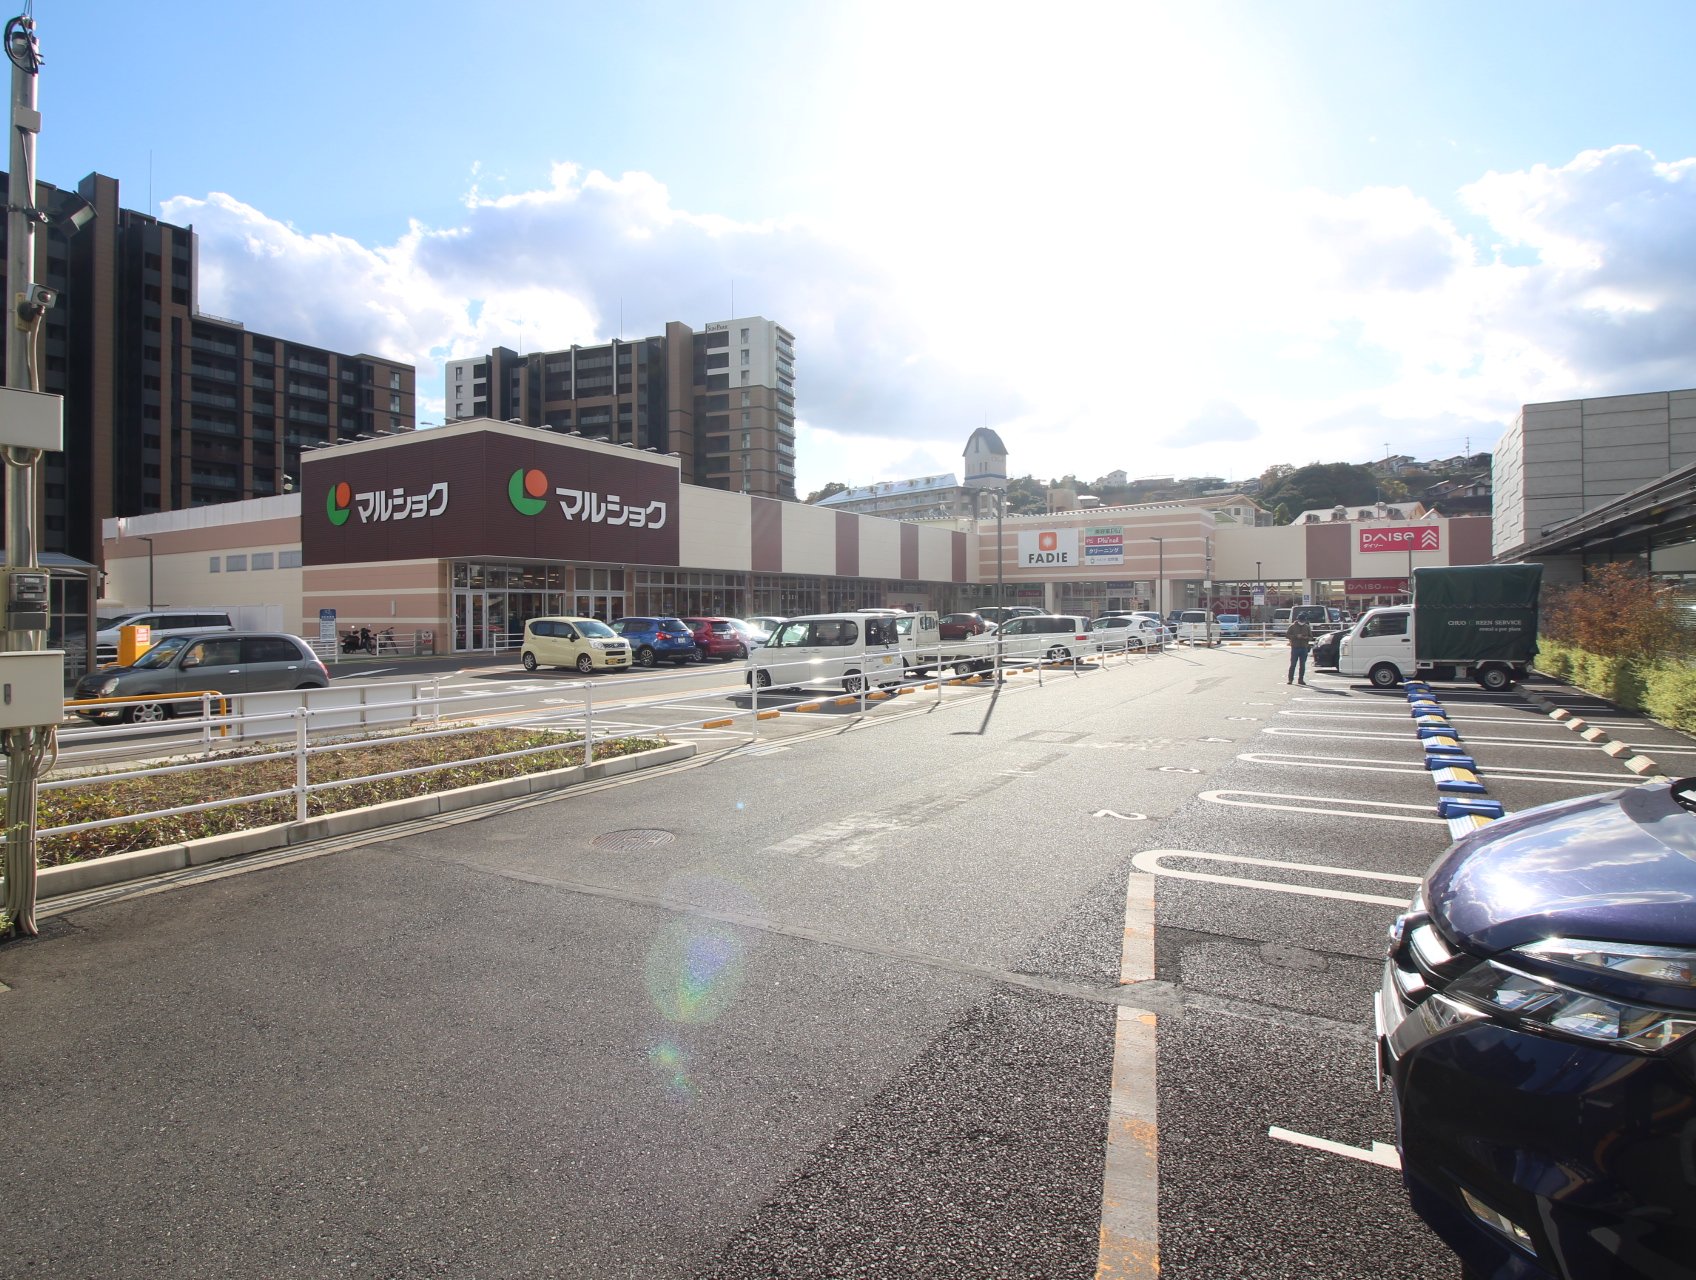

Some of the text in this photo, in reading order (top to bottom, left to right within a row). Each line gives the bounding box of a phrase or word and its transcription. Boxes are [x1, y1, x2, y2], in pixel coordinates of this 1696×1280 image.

[355, 481, 449, 524] マルショク
[555, 487, 667, 529] マルショク
[1088, 547, 1119, 555] クリーニング
[1028, 552, 1068, 564] FADIE
[1092, 809, 1148, 820] 2
